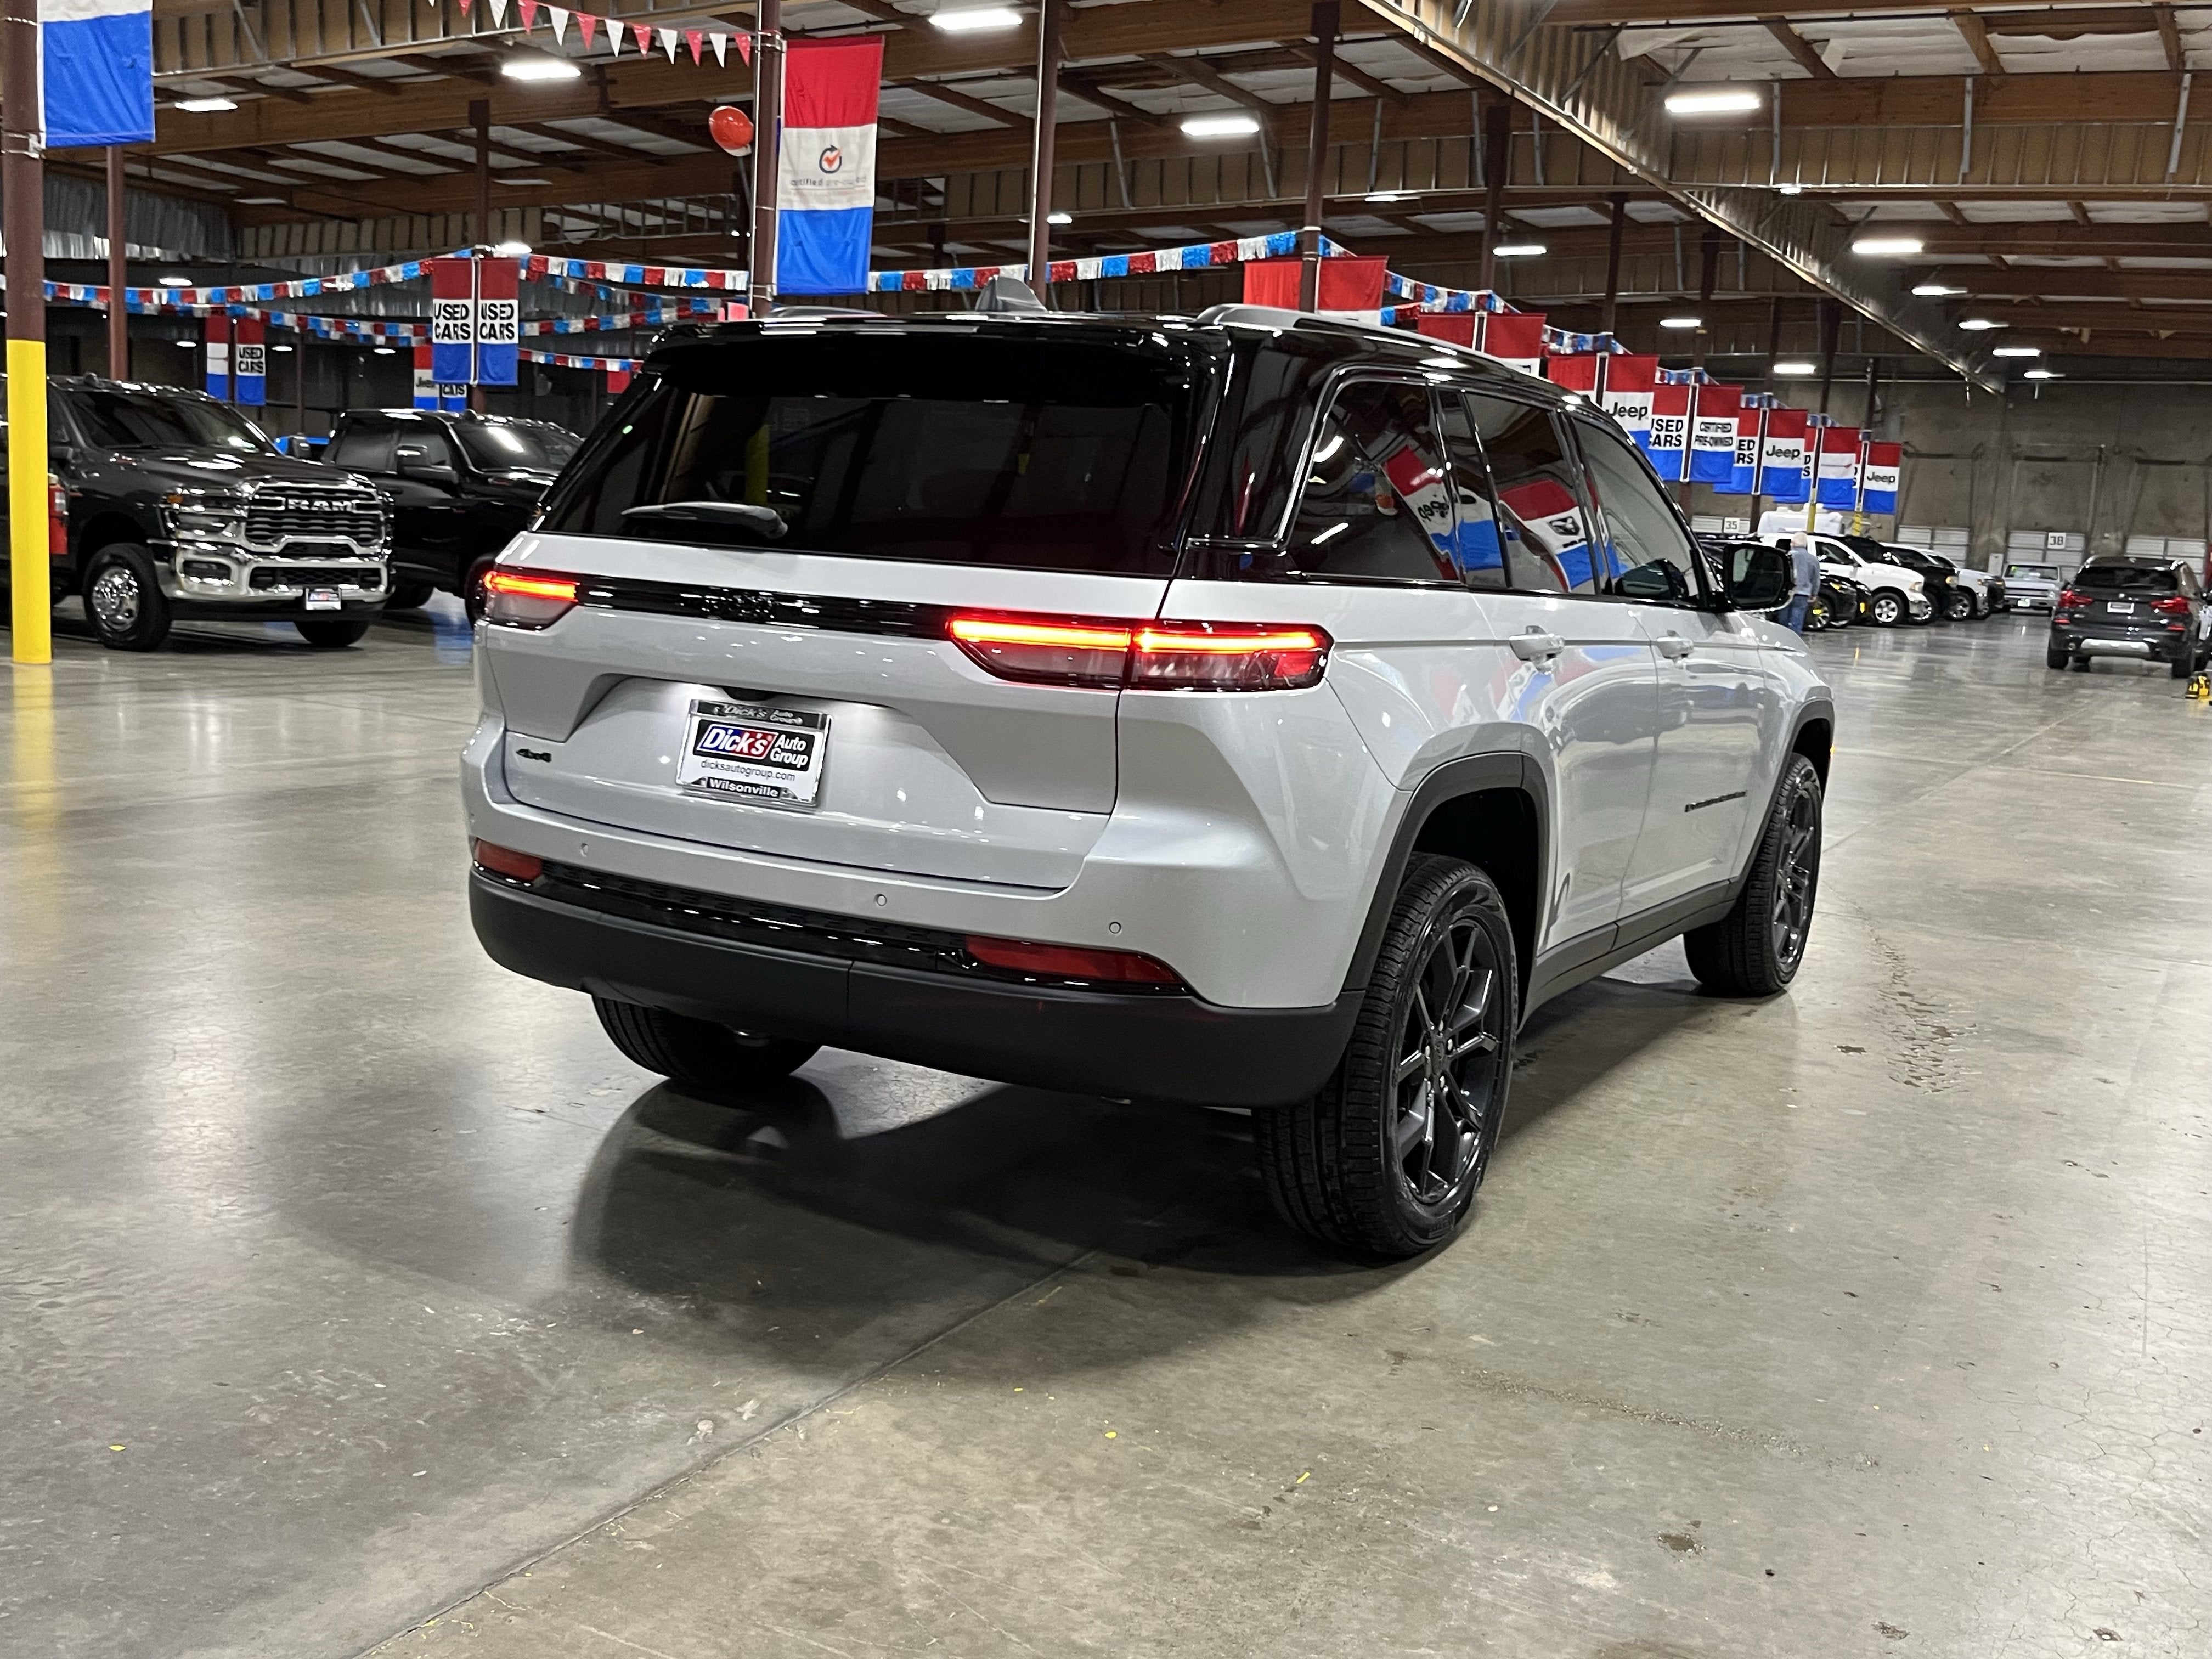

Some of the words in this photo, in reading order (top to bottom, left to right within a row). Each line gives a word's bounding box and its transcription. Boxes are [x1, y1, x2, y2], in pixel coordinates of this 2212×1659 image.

[435, 303, 470, 320] USED
[481, 303, 514, 320] USED
[435, 323, 471, 340] CARS
[479, 323, 515, 340] CARS
[239, 347, 263, 359] USED
[1605, 402, 1648, 420] Jeep
[1650, 434, 1683, 447] ARS
[1765, 445, 1801, 460] Jeep
[1866, 472, 1895, 485] Jeep
[288, 498, 352, 511] RAM
[1725, 521, 1737, 530] 35
[2049, 535, 2064, 546] 38
[702, 727, 769, 755] Dick's
[775, 734, 806, 752] Auto
[770, 749, 809, 769] Group
[700, 759, 795, 782] dicksautogroup.com
[709, 778, 779, 798] Wilsonville
